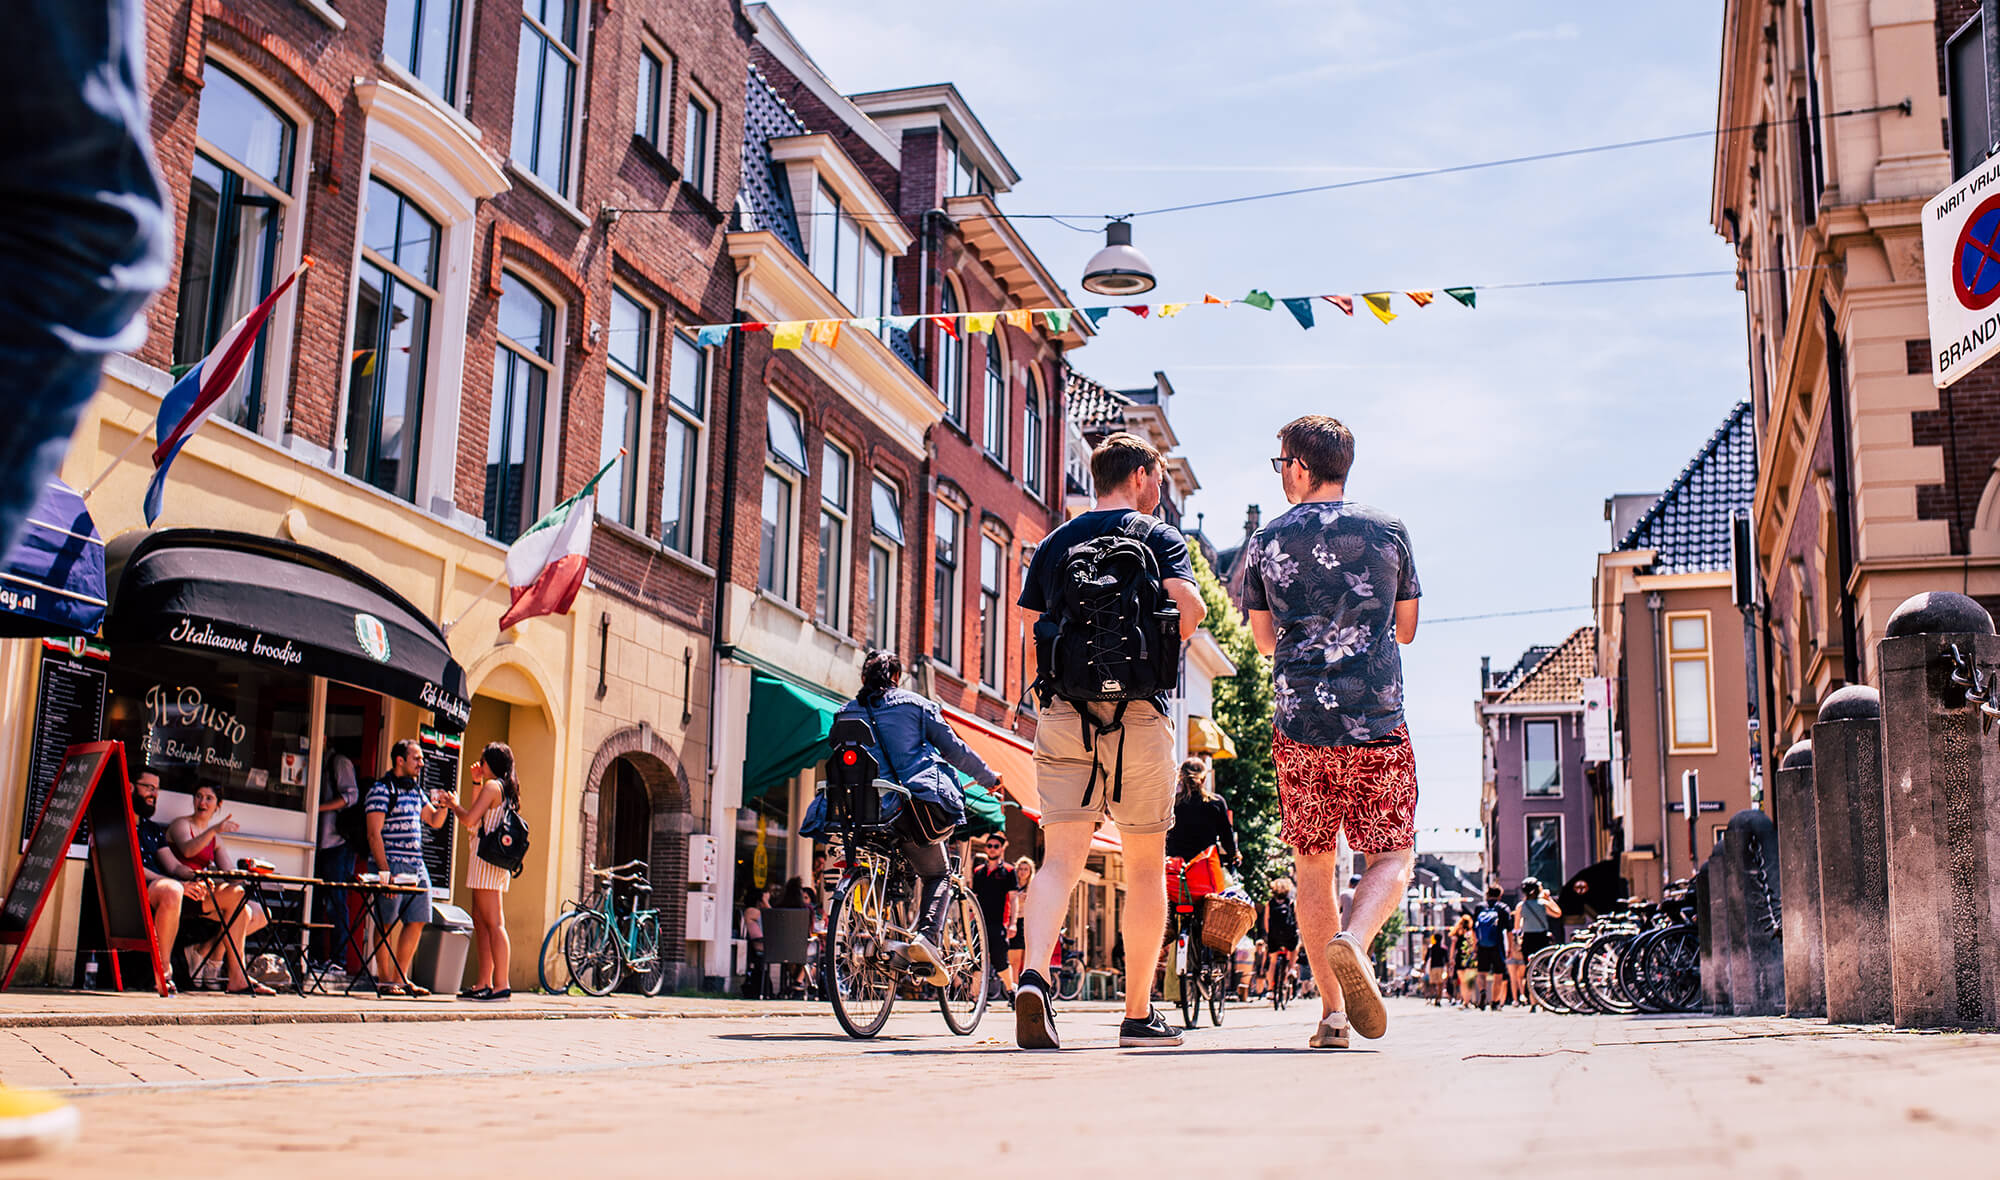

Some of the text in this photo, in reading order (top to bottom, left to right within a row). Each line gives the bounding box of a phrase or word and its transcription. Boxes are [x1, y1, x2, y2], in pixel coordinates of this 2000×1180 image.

[1936, 187, 1967, 220] INRIT
[170, 618, 302, 666] Italiaanse broodjes
[145, 684, 169, 729] Il
[177, 686, 246, 745] Gusto
